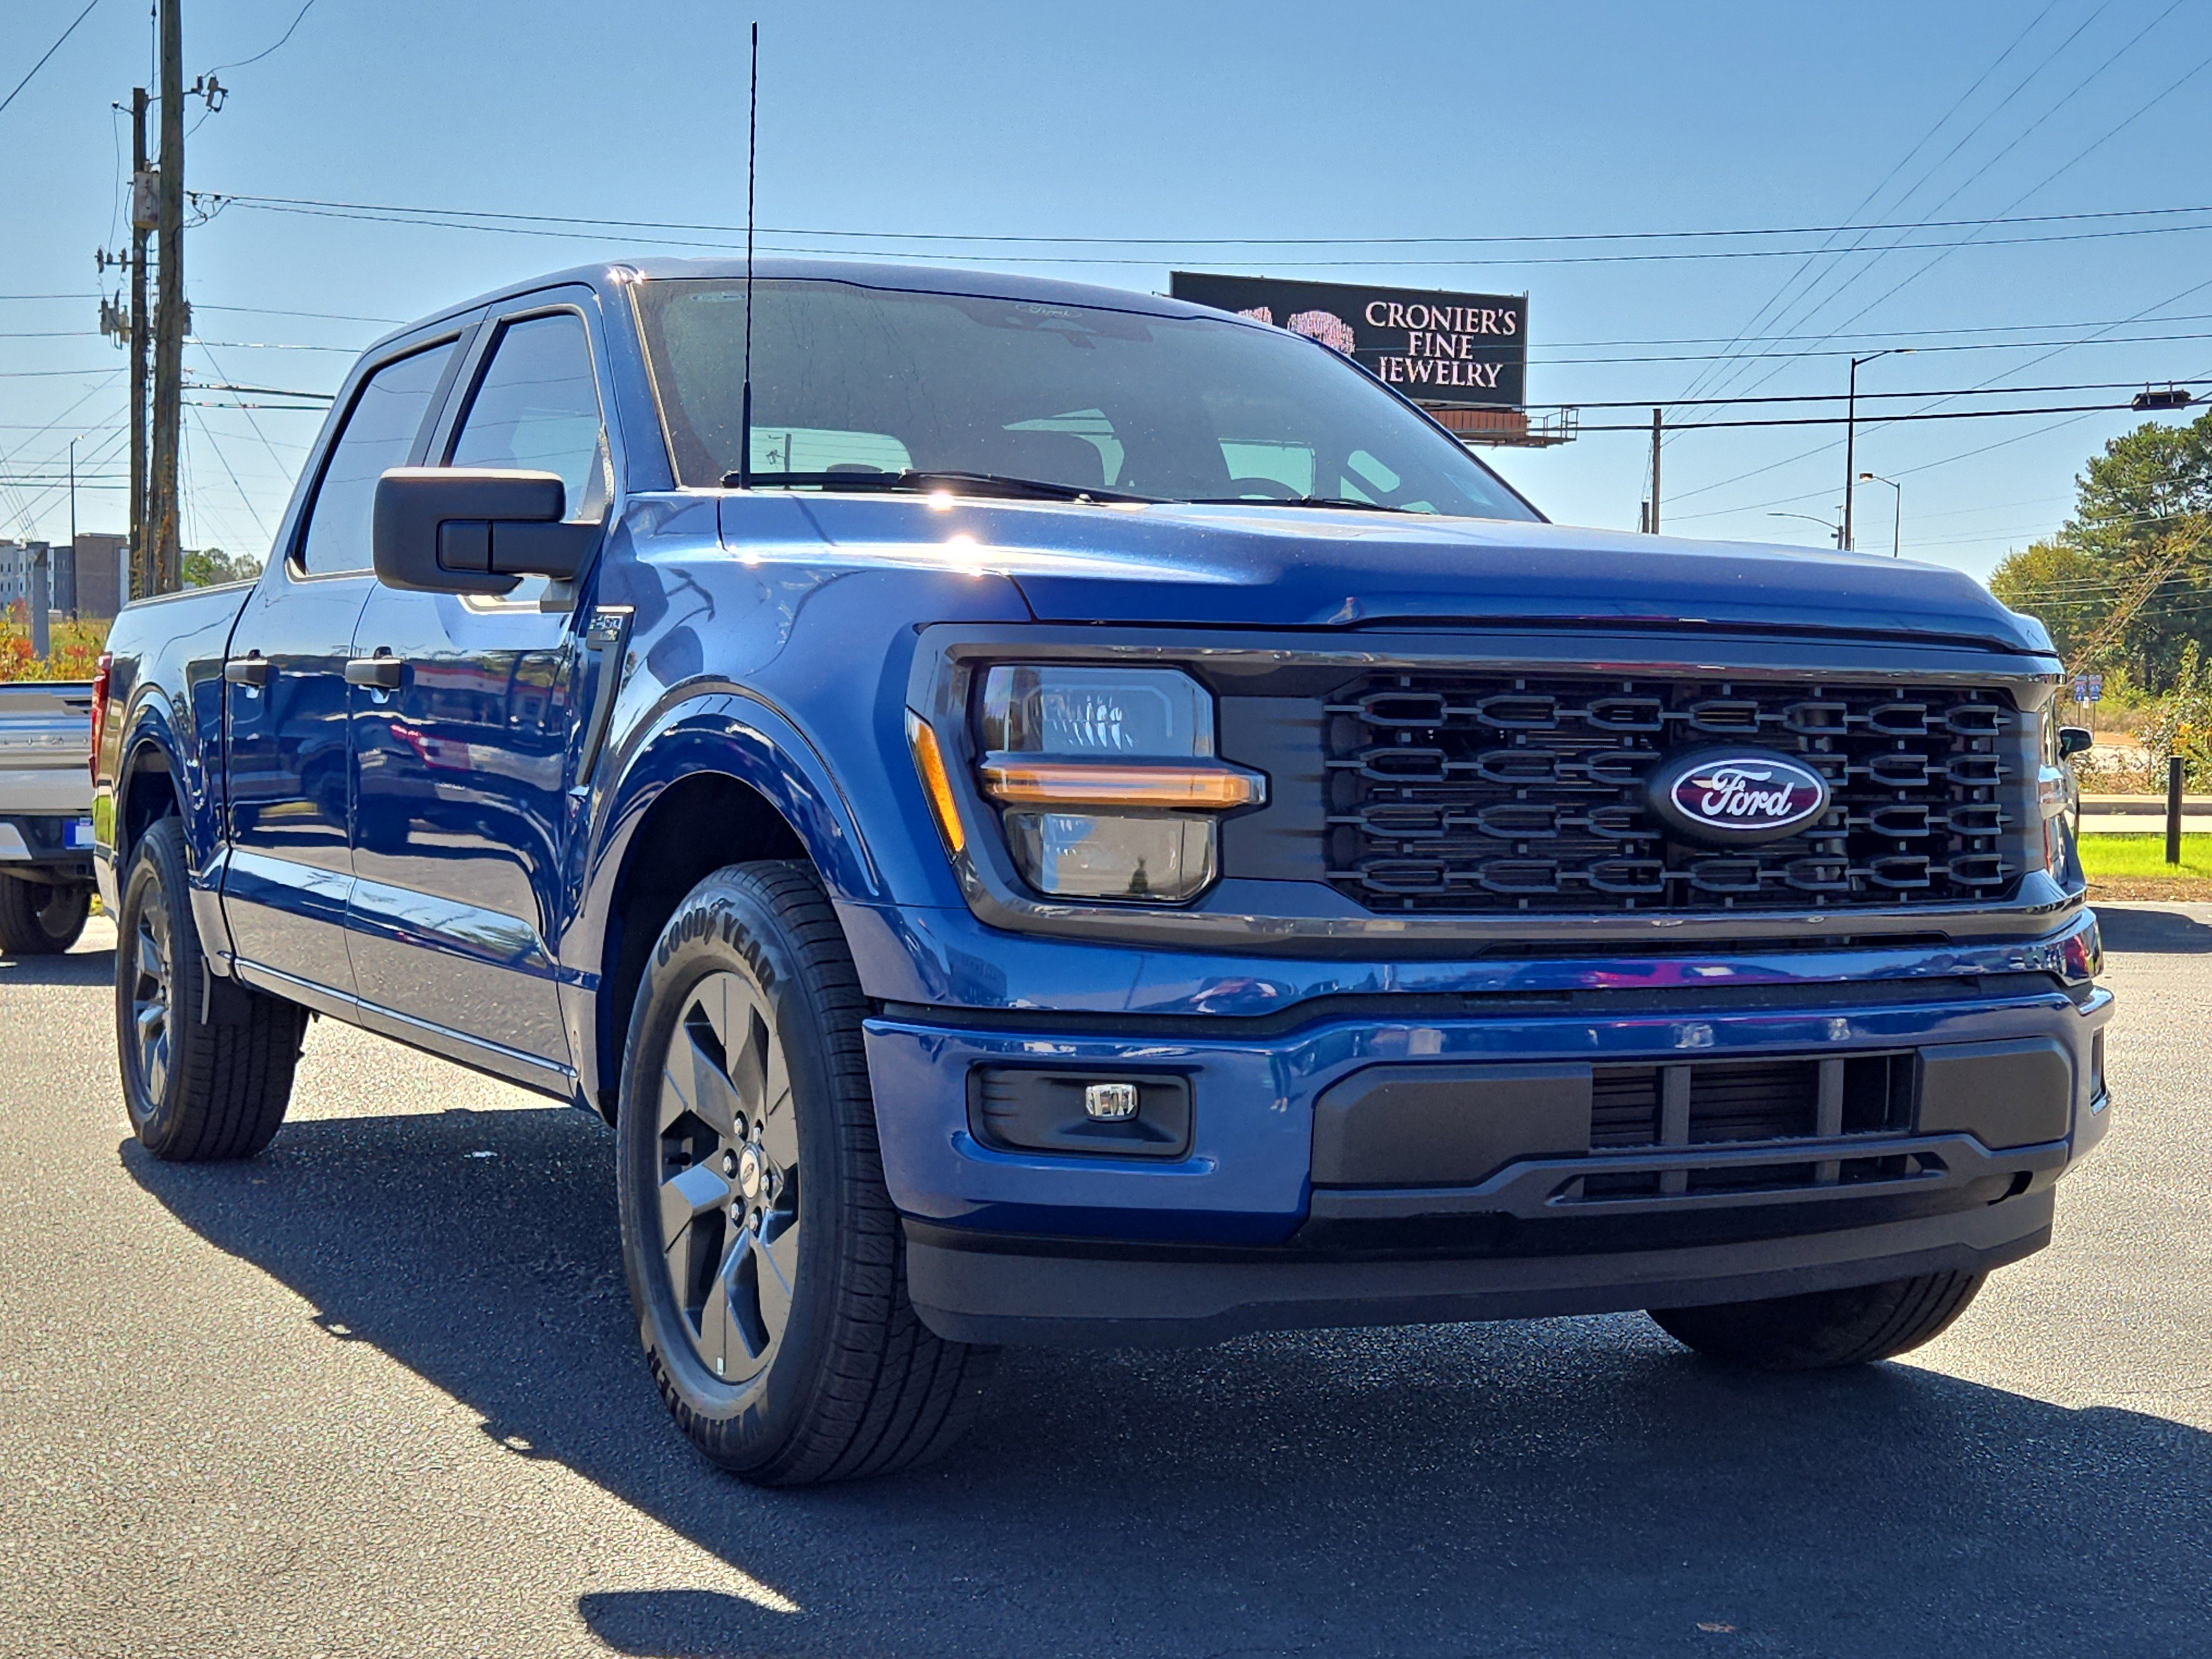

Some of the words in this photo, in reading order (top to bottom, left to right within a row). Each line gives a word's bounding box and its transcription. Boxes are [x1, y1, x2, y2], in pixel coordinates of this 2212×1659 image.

[1365, 301, 1517, 336] CRONIER'S
[1408, 331, 1475, 360] FINE
[1379, 356, 1503, 388] JEWELRY
[1692, 768, 1795, 816] Ford
[657, 906, 776, 996] GOODYEAR
